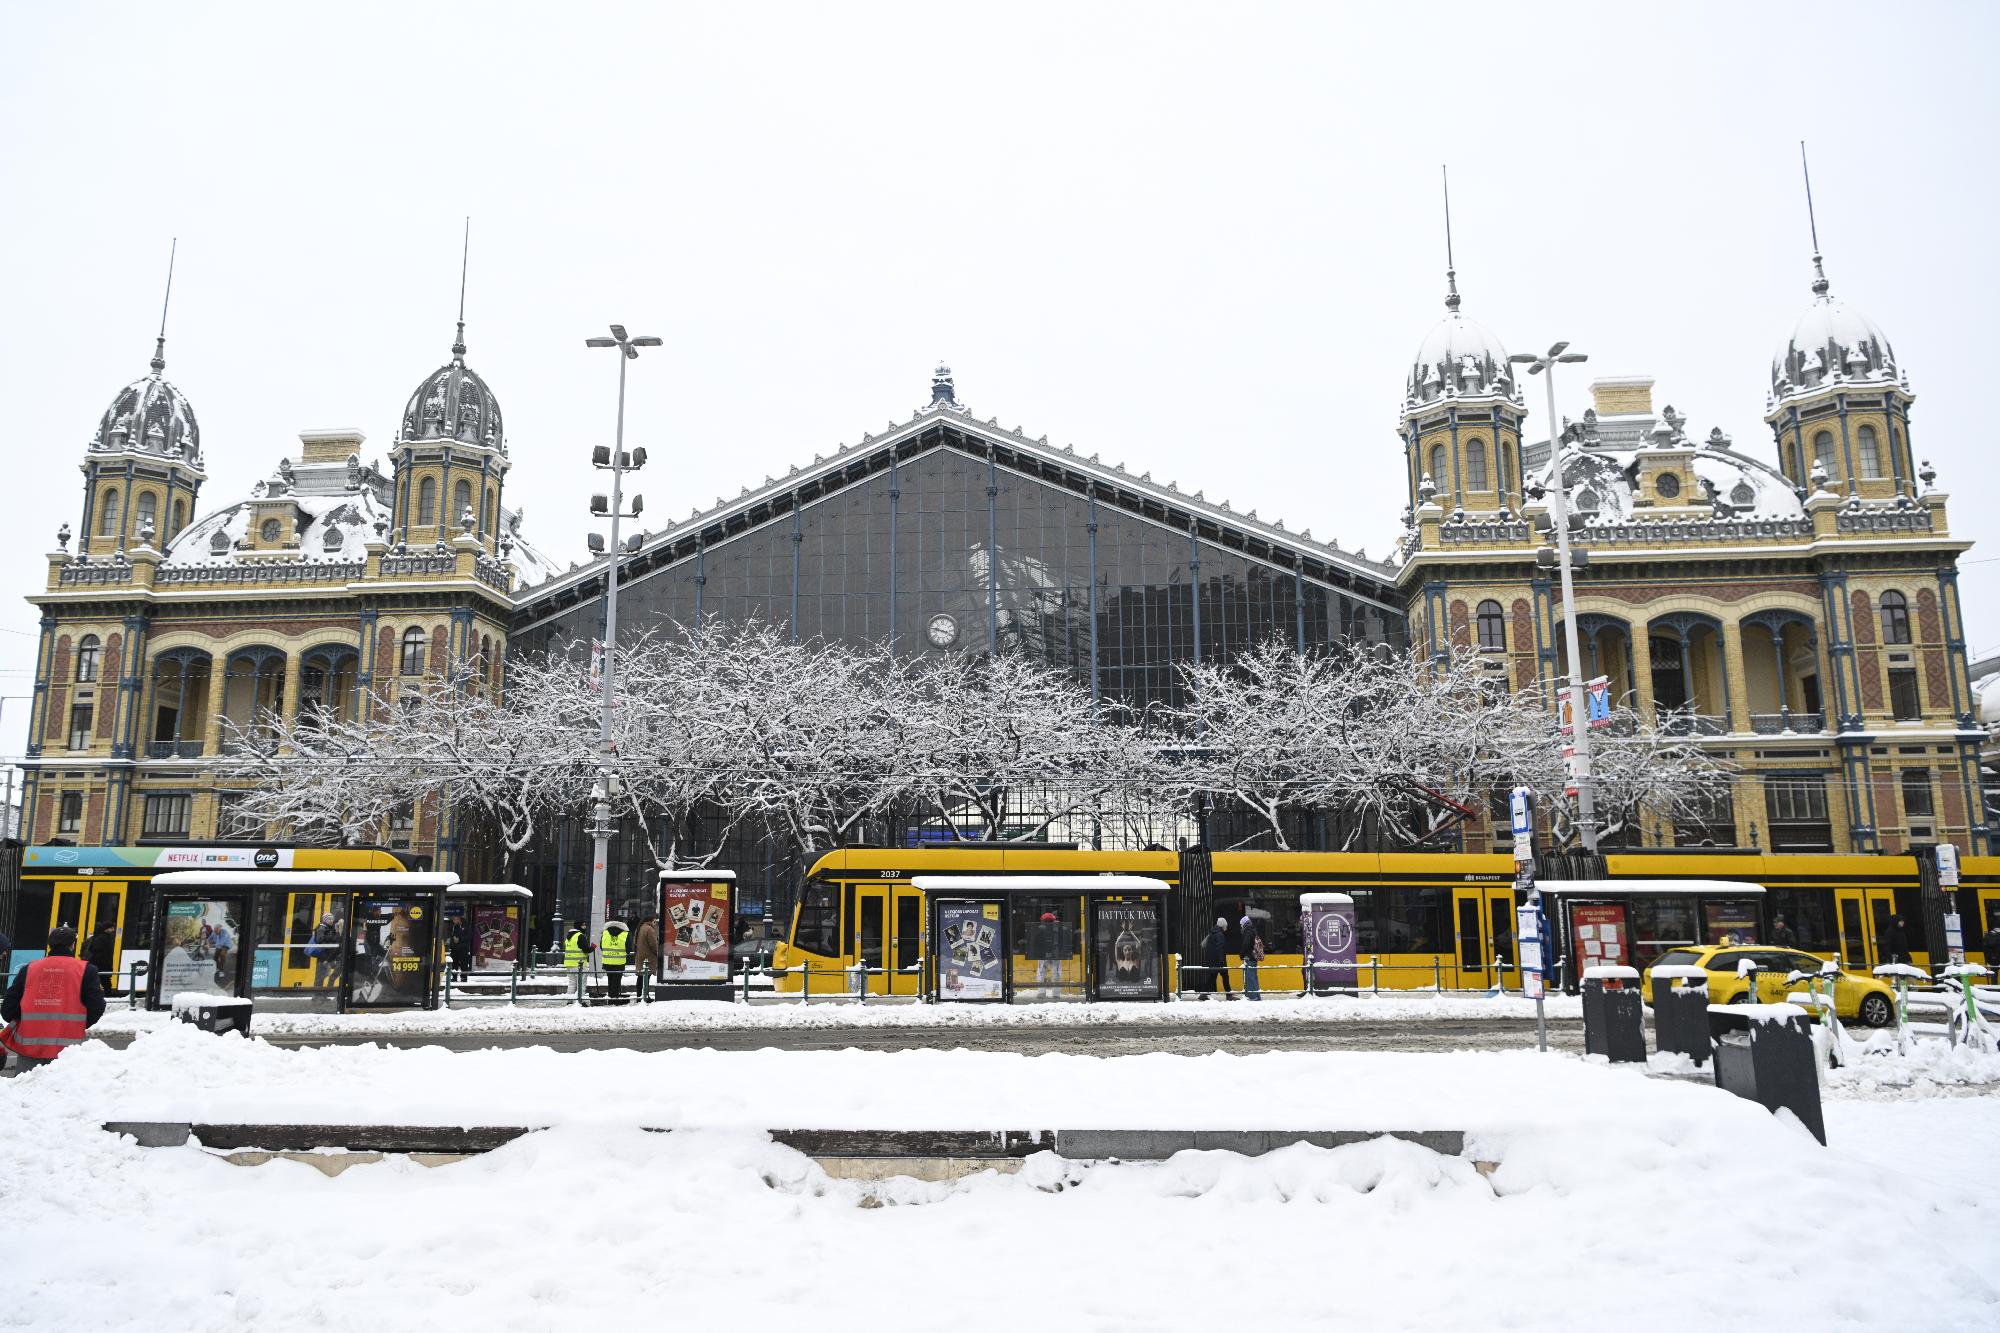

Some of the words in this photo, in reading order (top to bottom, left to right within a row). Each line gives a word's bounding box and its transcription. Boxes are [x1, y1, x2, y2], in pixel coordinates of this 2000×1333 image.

[168, 853, 199, 863] NETFLIX
[256, 853, 277, 862] one
[880, 870, 901, 878] 2037
[1098, 908, 1135, 920] HATTYÚK
[1136, 910, 1156, 920] TAVA
[393, 962, 401, 971] 14
[402, 962, 418, 971] 999
